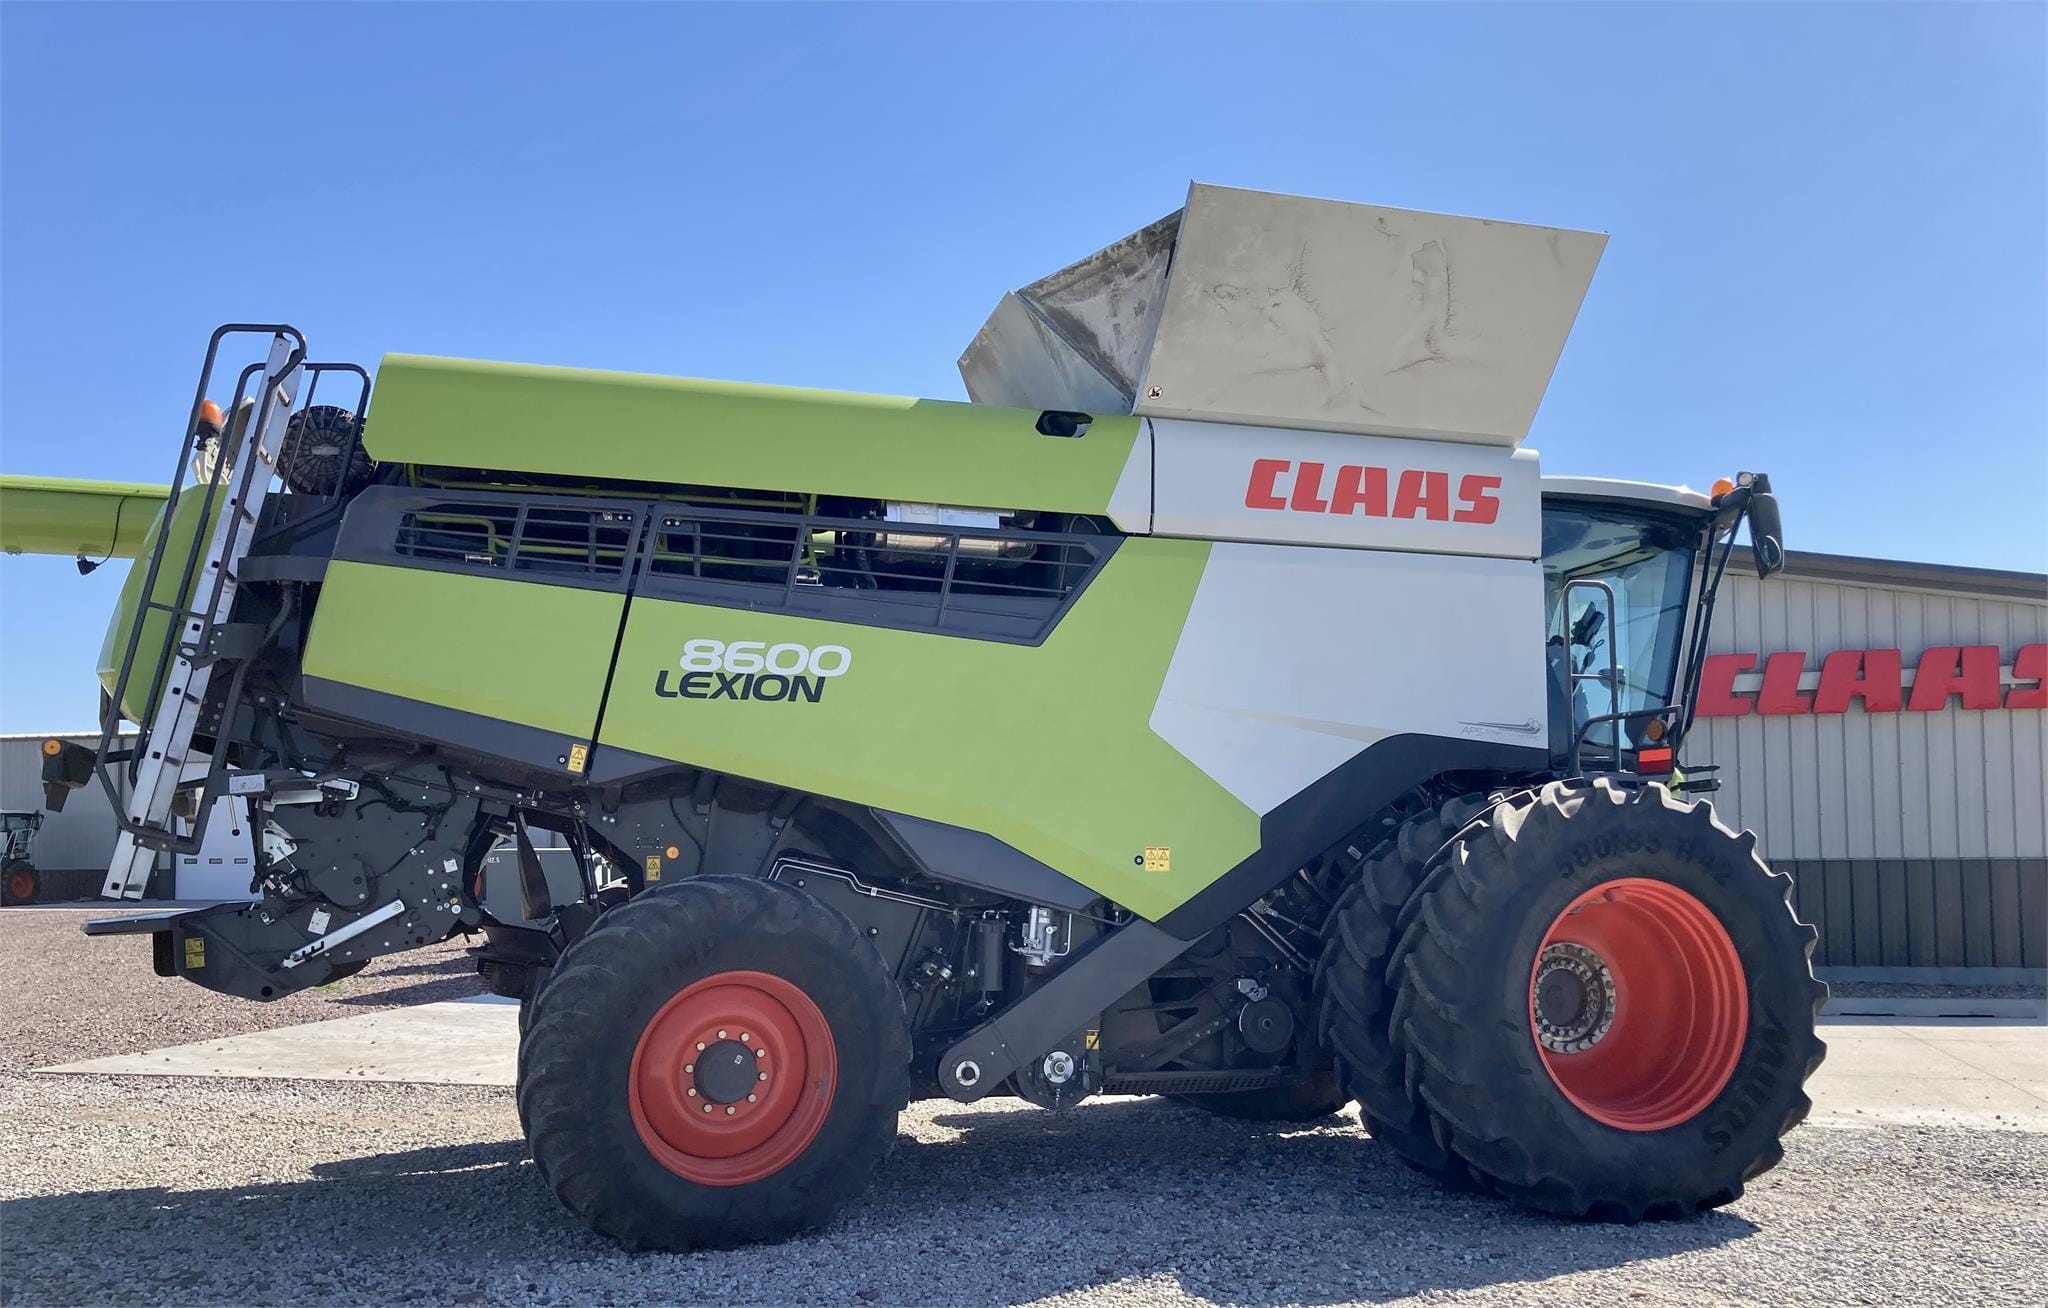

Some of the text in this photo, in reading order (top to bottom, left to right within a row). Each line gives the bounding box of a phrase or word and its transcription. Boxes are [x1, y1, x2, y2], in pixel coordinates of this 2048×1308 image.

[1244, 458, 1503, 525] CLAAS
[679, 638, 852, 677] 8600
[655, 670, 826, 703] LEXION
